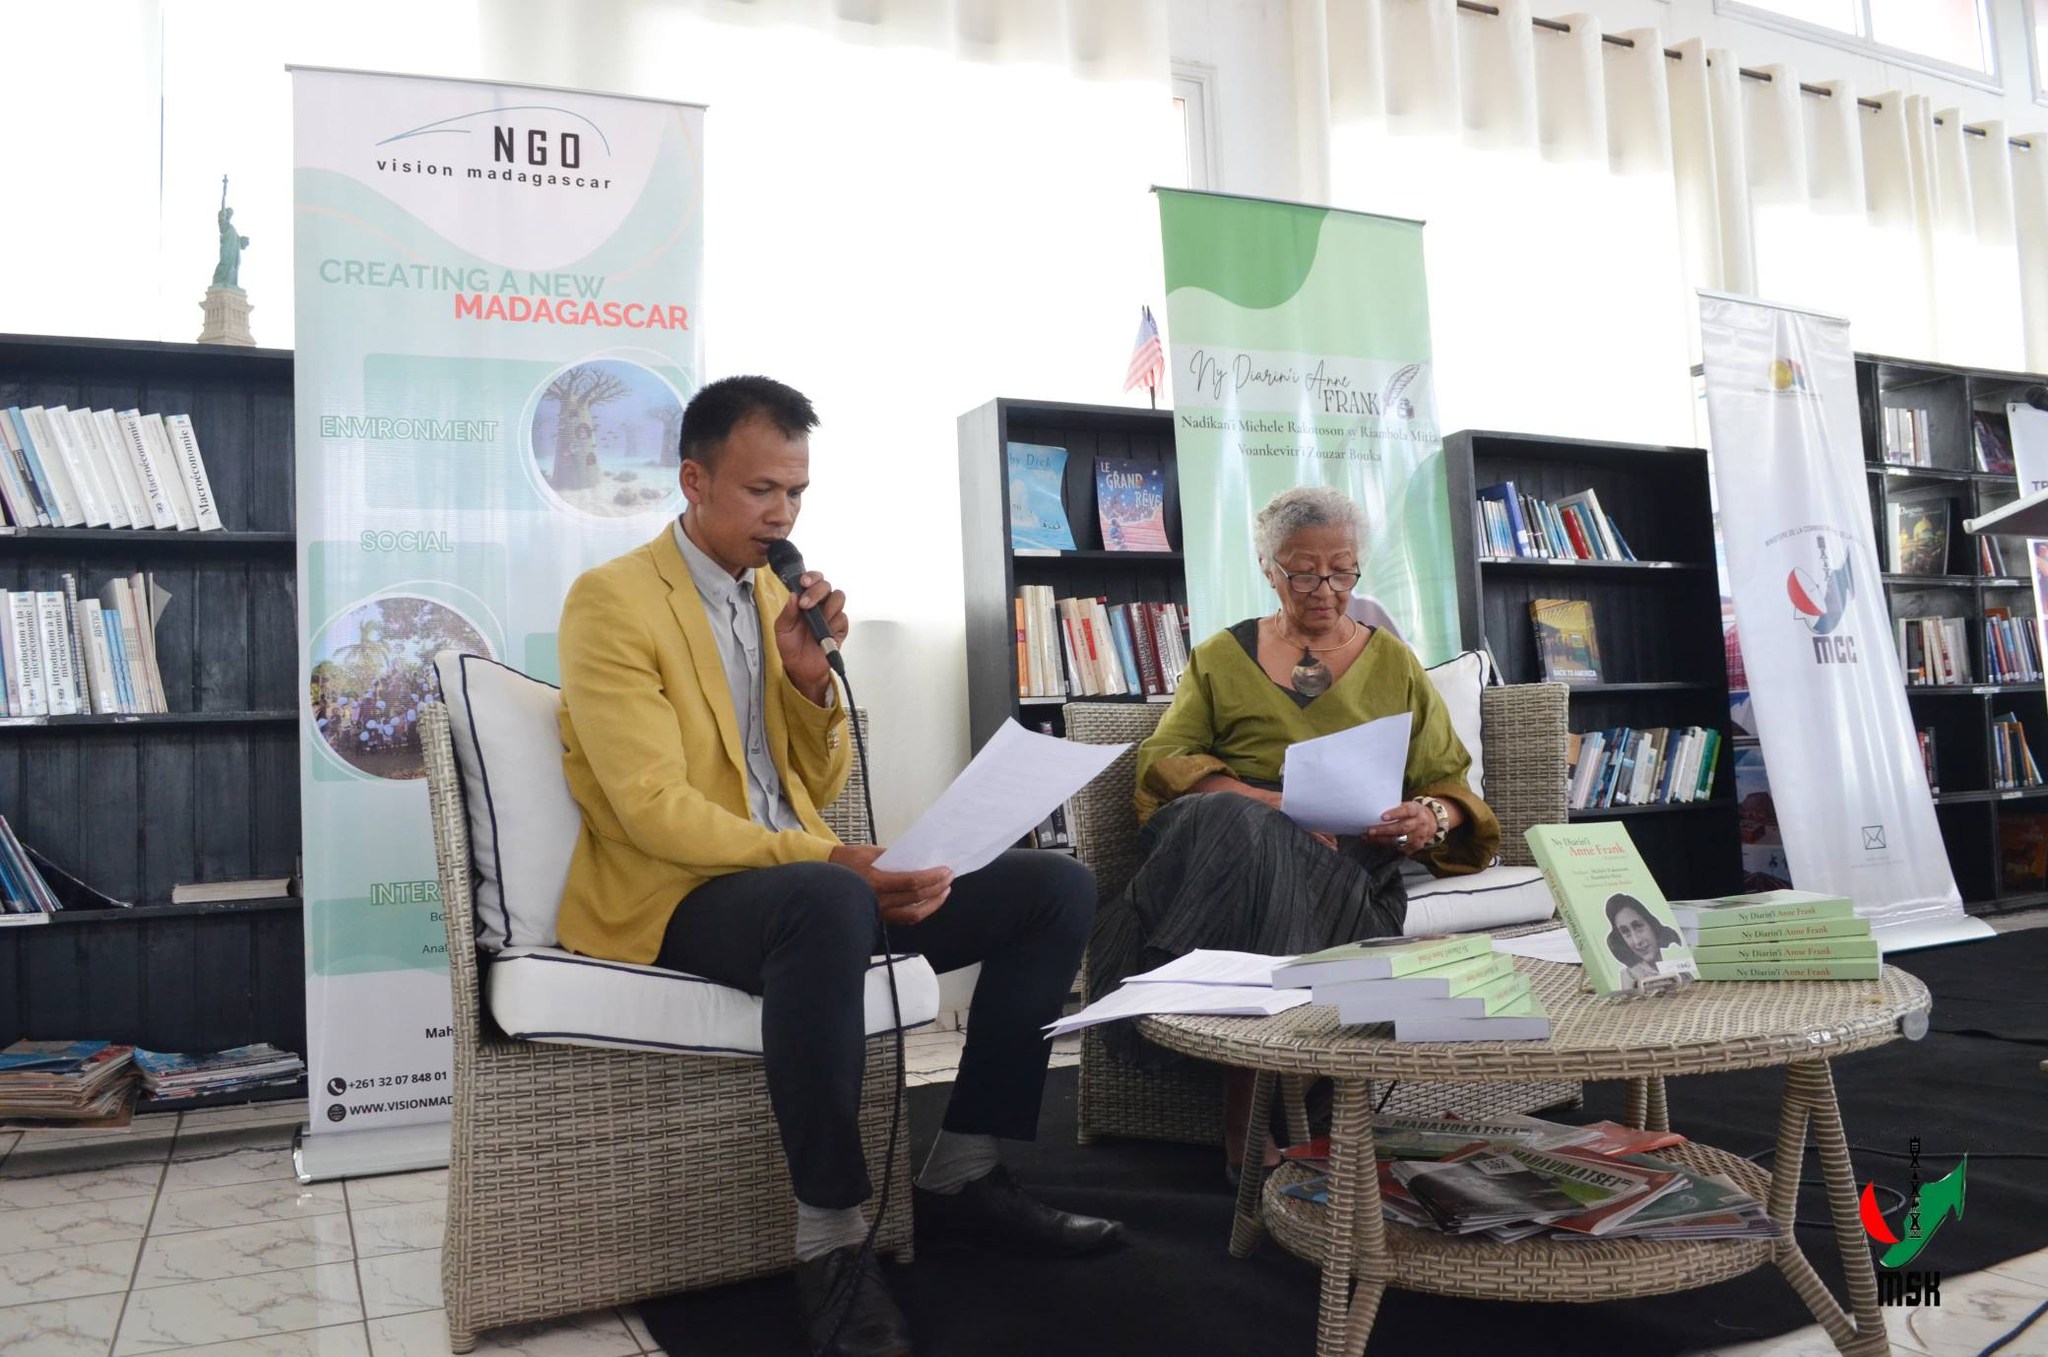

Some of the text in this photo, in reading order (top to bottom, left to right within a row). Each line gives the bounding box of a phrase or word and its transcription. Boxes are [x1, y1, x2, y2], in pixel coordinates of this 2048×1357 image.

[493, 126, 580, 169] NGO
[376, 158, 611, 190] vision madagascar
[319, 258, 605, 300] CREATING A NEW
[454, 293, 688, 331] MADAGASCAR
[1304, 360, 1351, 399] Anne
[1324, 389, 1380, 416] FRANK
[320, 415, 498, 442] ENVIRONMENT
[178, 428, 212, 516] Macroéconomie
[1026, 453, 1053, 469] Dick
[1100, 461, 1111, 473] LE
[1105, 472, 1144, 490] GRAND
[361, 529, 454, 553] SOCIAL
[18, 630, 31, 687] Introduction
[46, 630, 60, 687] Introduction
[1568, 842, 1625, 857] Anne Frank
[1796, 905, 1816, 915] Frank
[1785, 928, 1805, 937] Anne
[1806, 924, 1828, 934] Frank
[1784, 948, 1806, 957] Anne
[1808, 946, 1831, 955] Frank
[1782, 968, 1805, 976] Anne
[1806, 967, 1831, 976] Frank
[425, 1026, 454, 1039] Mah
[347, 1070, 448, 1090] +261 32 07 848 01
